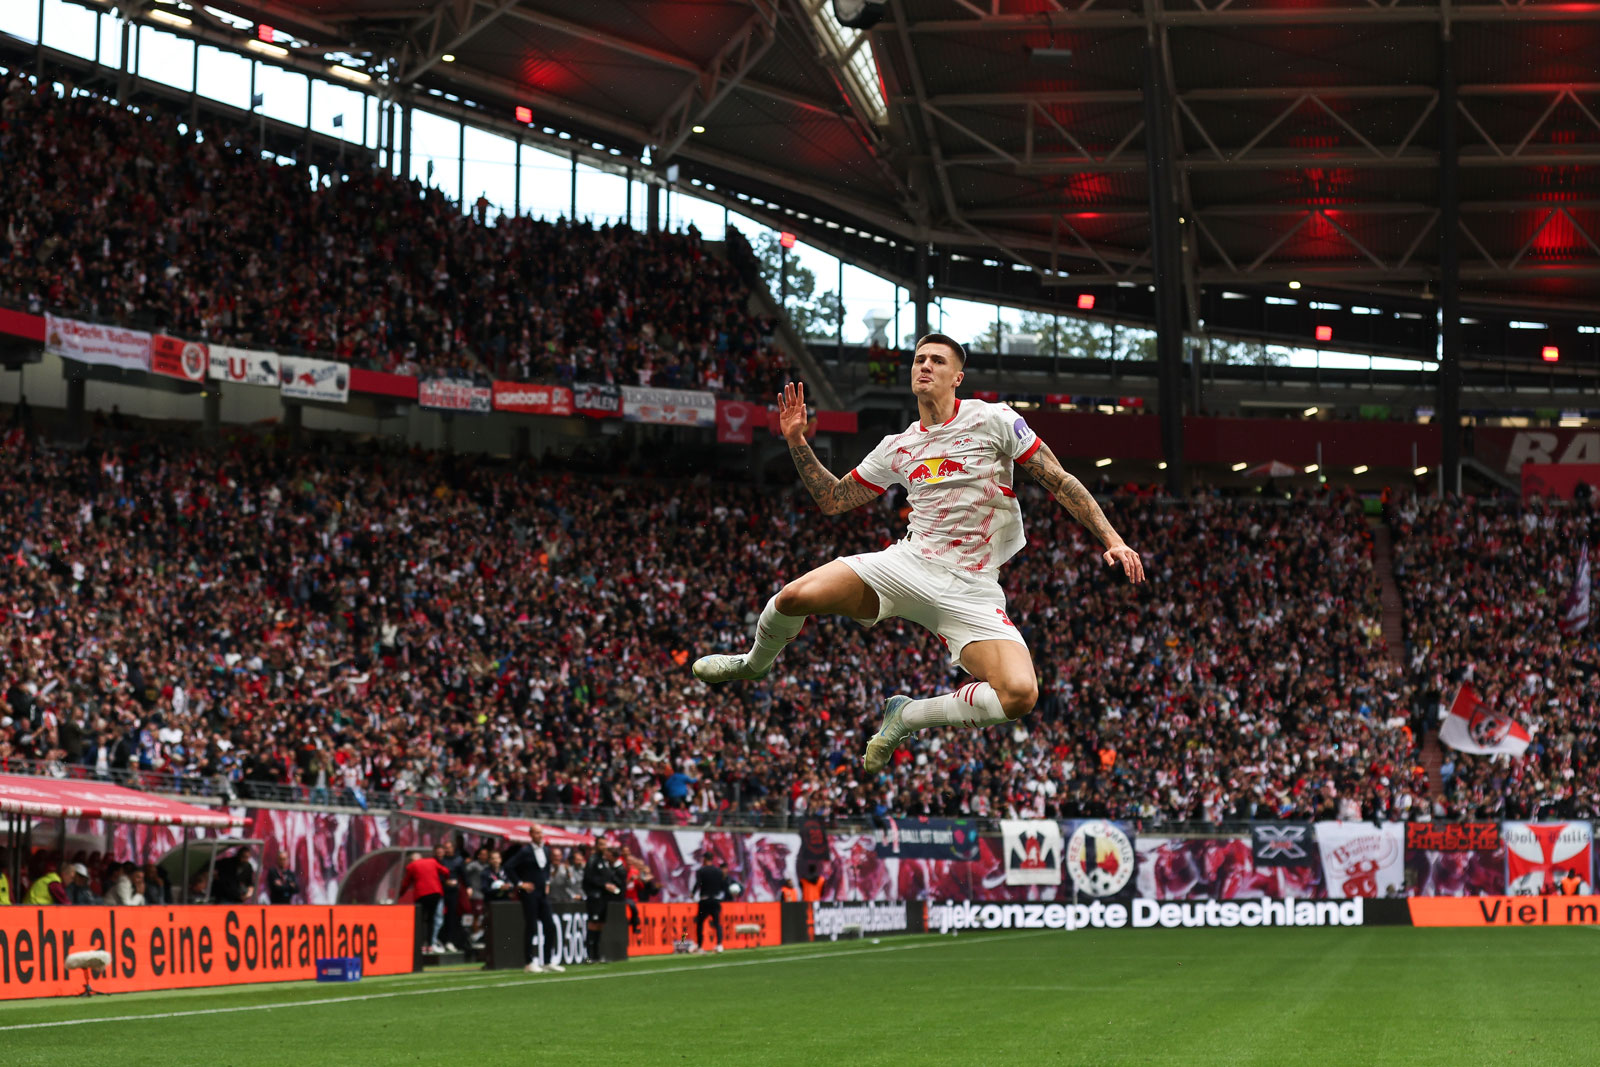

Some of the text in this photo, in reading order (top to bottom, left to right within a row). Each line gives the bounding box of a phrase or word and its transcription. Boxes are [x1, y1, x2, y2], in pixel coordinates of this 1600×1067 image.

[1070, 836, 1083, 862] RED
[1132, 896, 1364, 928] Deutschland
[1479, 898, 1548, 923] Viel
[90, 910, 136, 979] als
[150, 912, 213, 977] eine
[225, 908, 379, 972] Solaranlage
